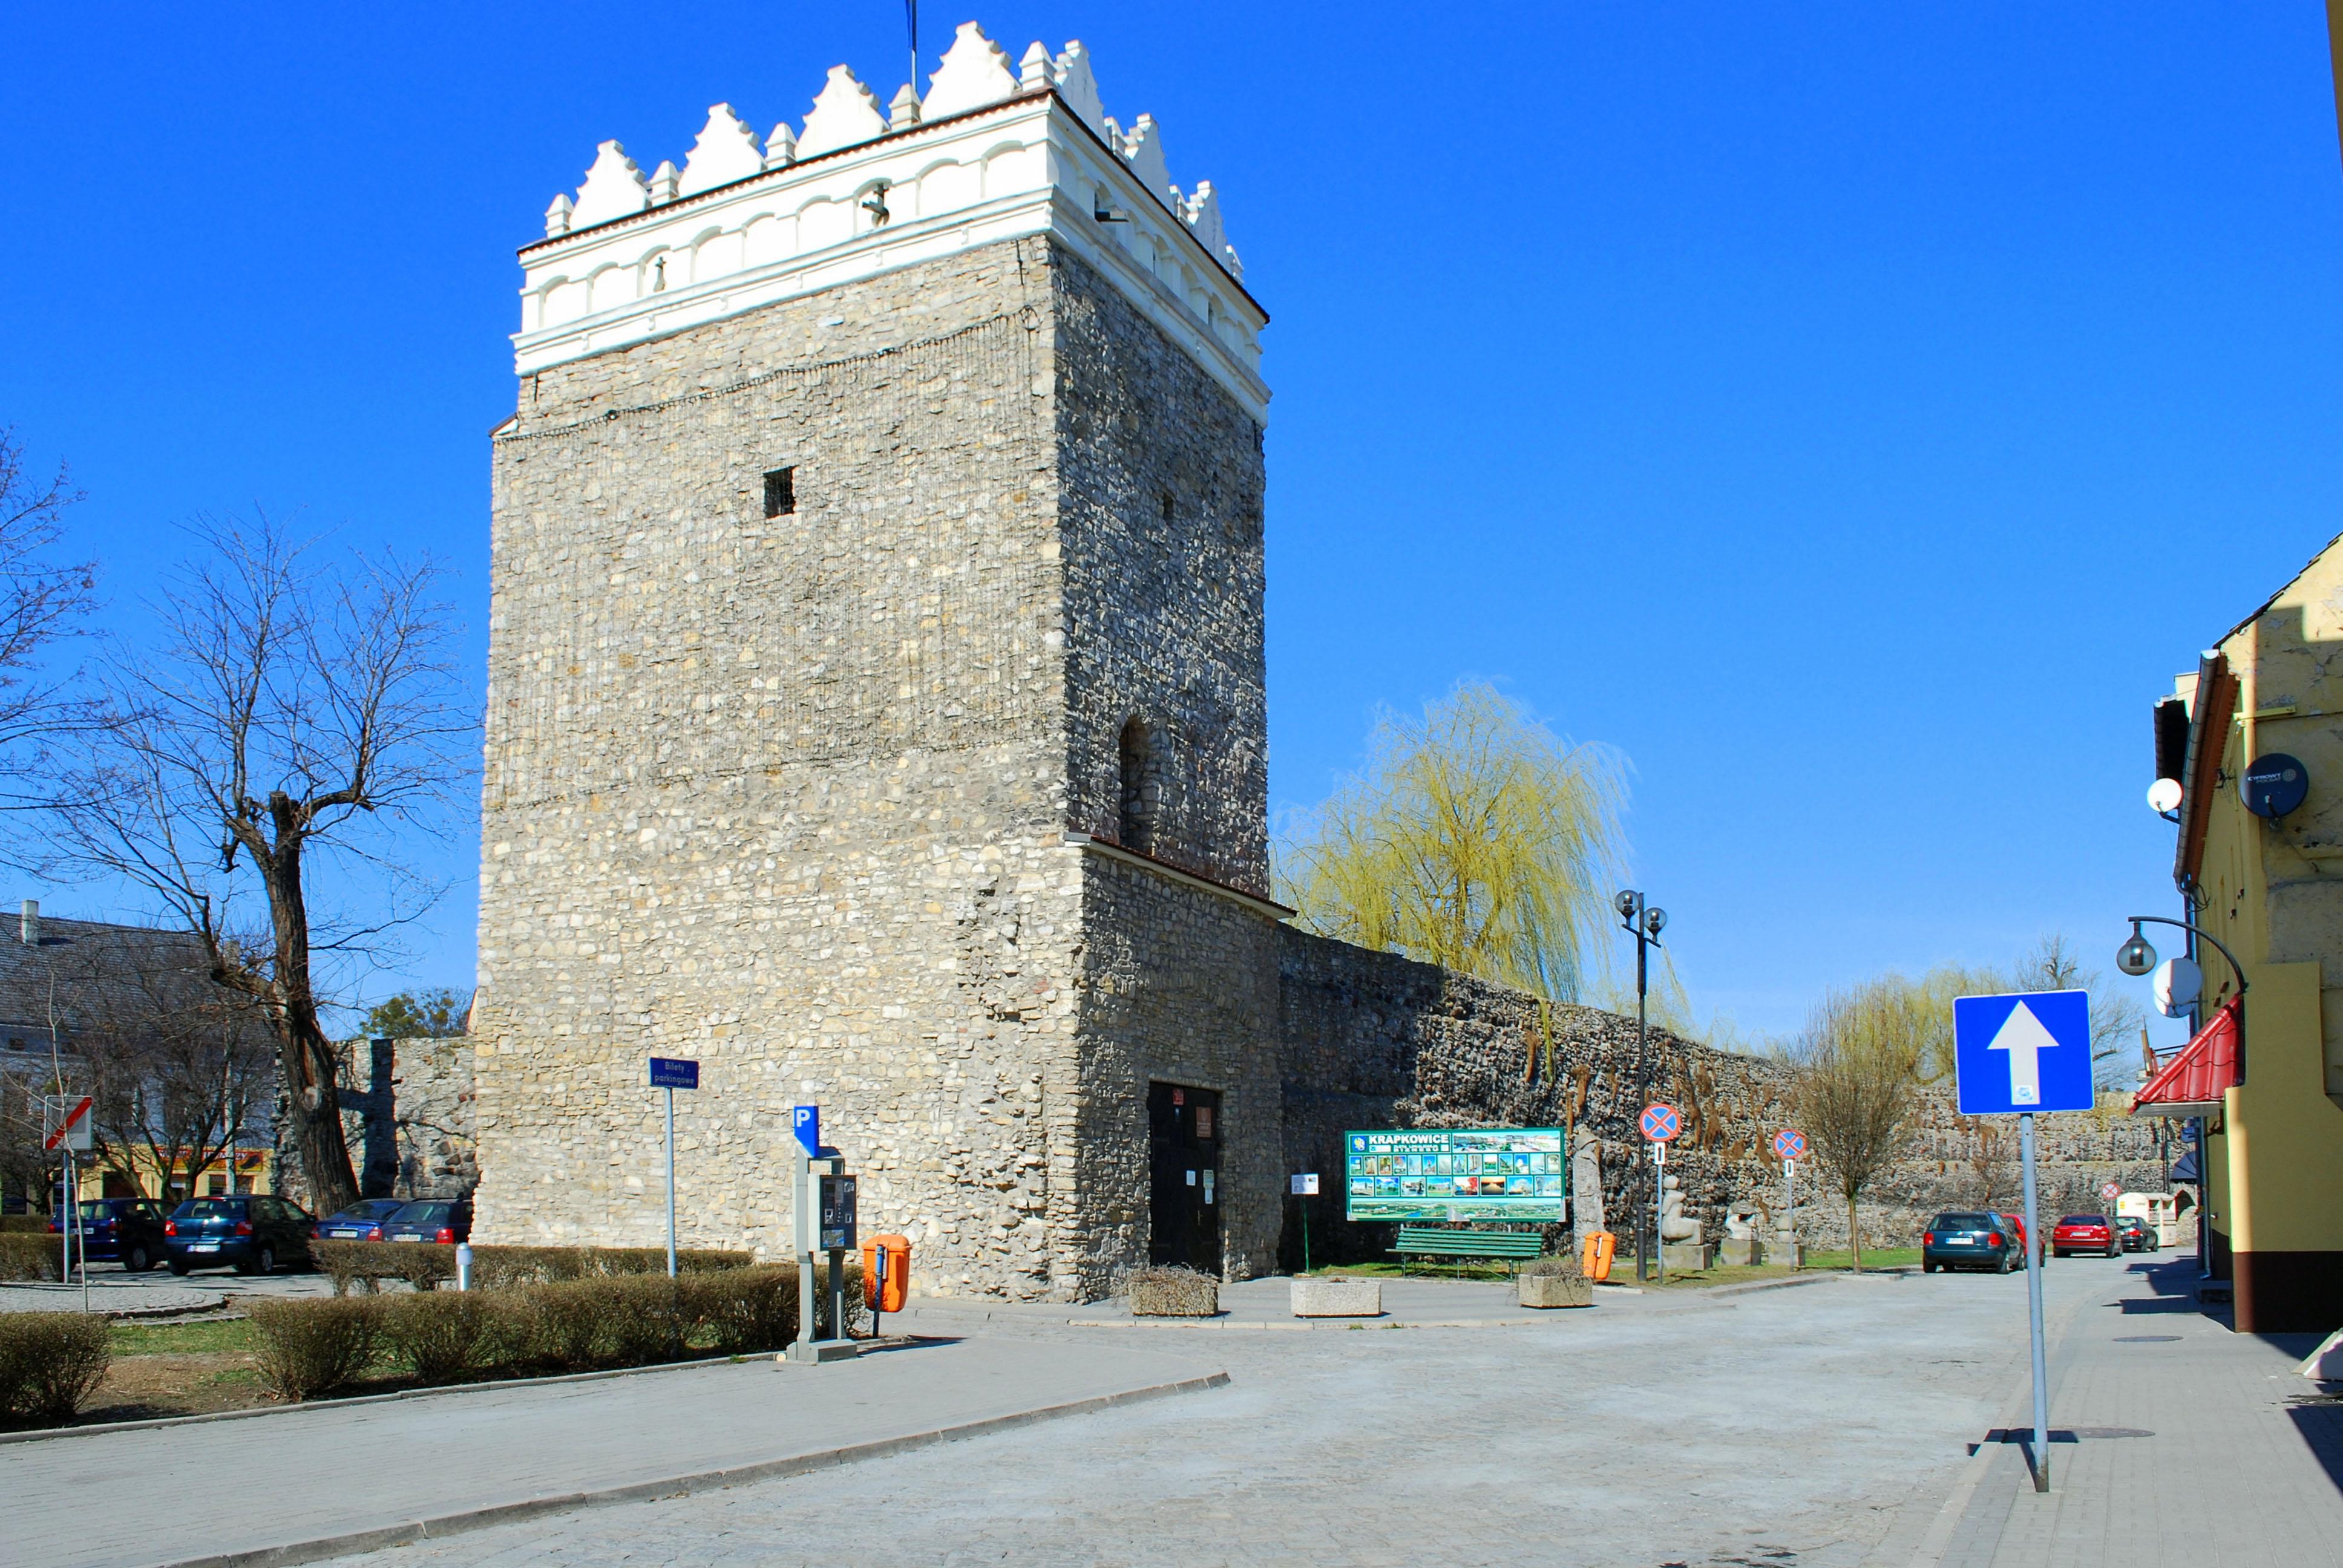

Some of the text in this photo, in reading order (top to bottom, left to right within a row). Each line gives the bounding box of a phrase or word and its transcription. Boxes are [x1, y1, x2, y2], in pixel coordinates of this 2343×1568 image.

[665, 1062, 685, 1074] Bilety
[655, 1074, 695, 1085] parkingowe
[796, 1109, 810, 1127] P
[1369, 1134, 1449, 1145] KRAPKOWICE
